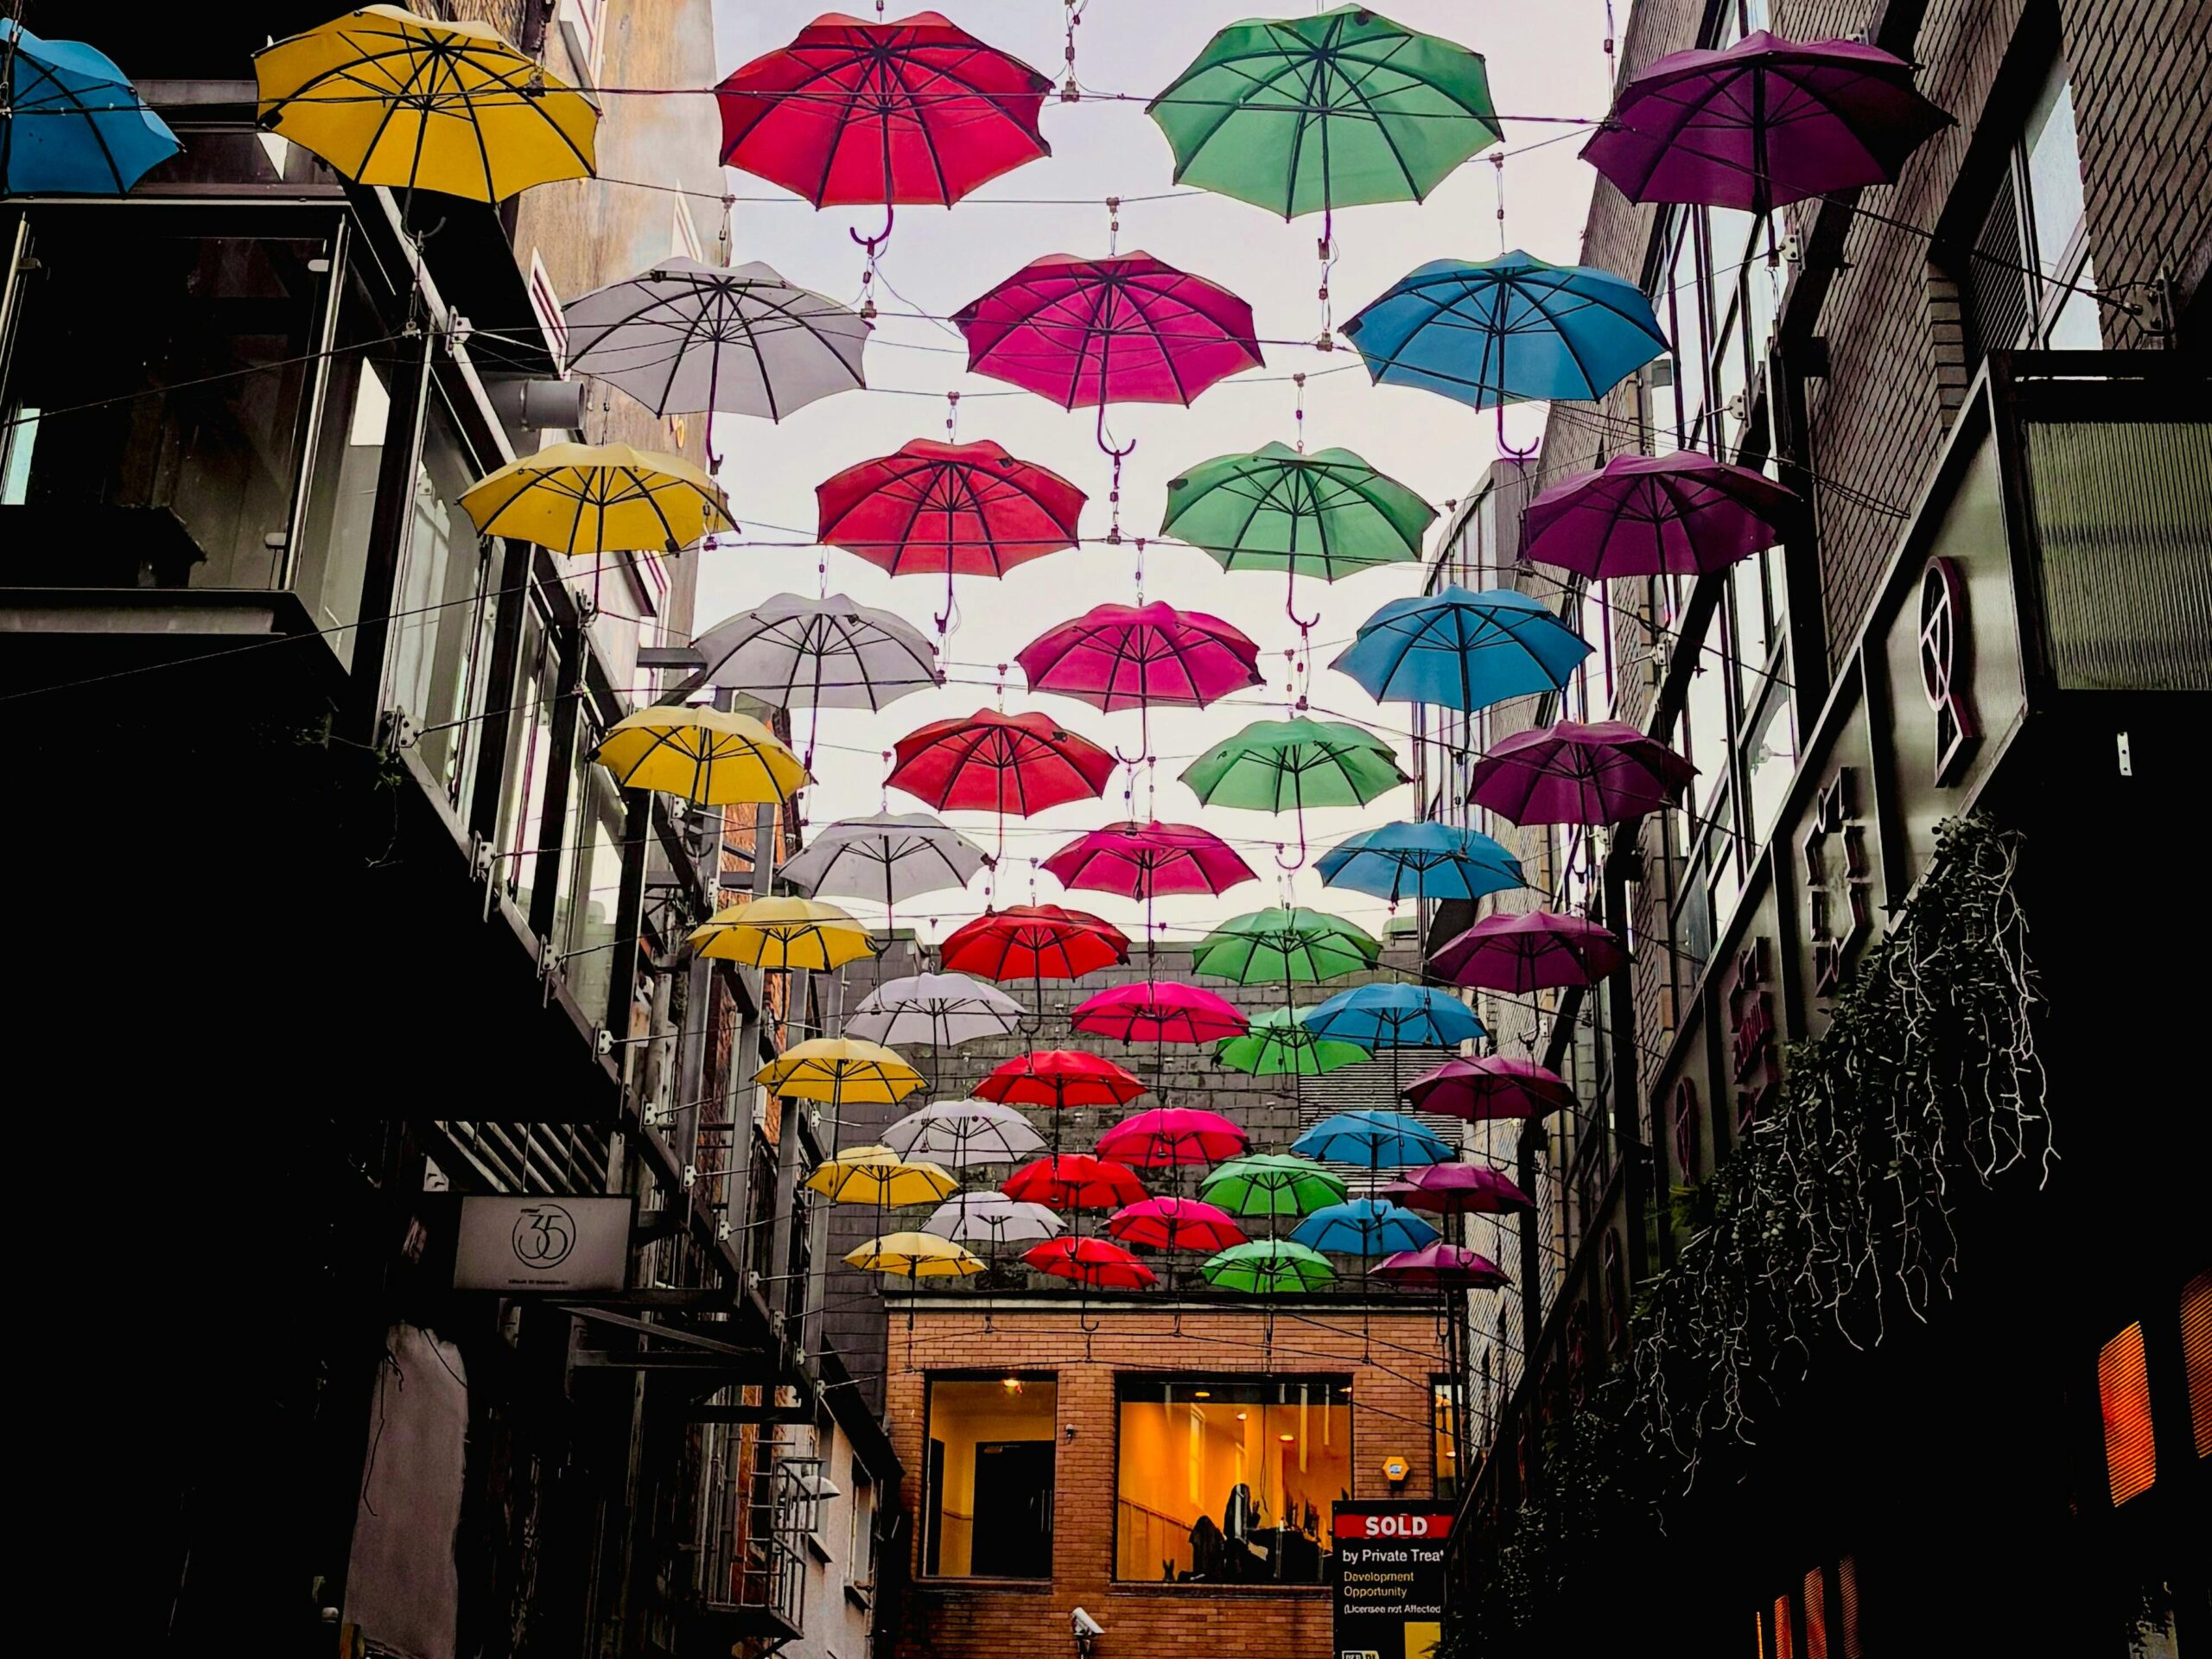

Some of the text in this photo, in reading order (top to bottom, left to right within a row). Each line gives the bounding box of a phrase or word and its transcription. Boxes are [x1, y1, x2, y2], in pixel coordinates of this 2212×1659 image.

[518, 1214, 569, 1260] 35
[1365, 1516, 1427, 1535] SOLD
[1342, 1549, 1358, 1565] by
[1362, 1548, 1408, 1562] Private
[1344, 1571, 1414, 1583] Development
[1344, 1586, 1408, 1599] Opportunity
[1387, 1605, 1402, 1614] not
